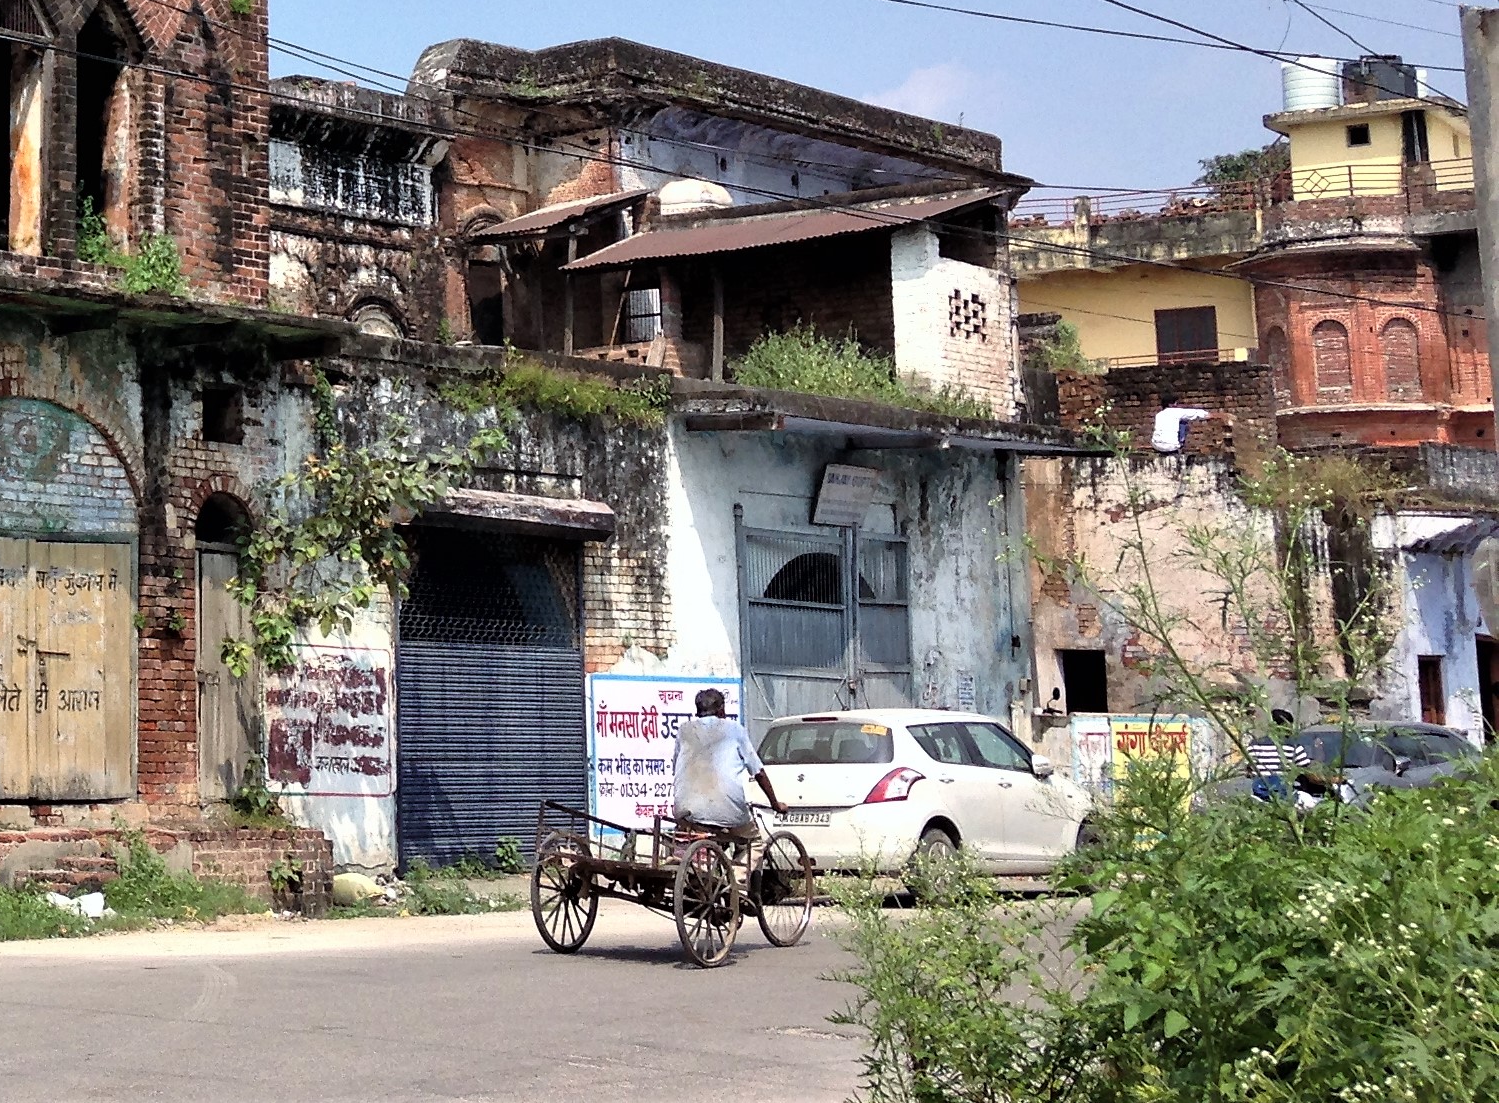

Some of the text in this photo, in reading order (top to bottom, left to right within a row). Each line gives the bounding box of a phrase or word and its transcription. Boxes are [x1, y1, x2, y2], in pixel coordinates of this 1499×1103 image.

[35, 682, 49, 713] ही
[658, 690, 683, 706] सूचना
[609, 711, 640, 738] मनसा
[641, 705, 658, 743] देवी
[1116, 723, 1147, 757] गंगा
[598, 758, 613, 775] कम
[633, 758, 644, 775] का
[645, 758, 665, 776] समय
